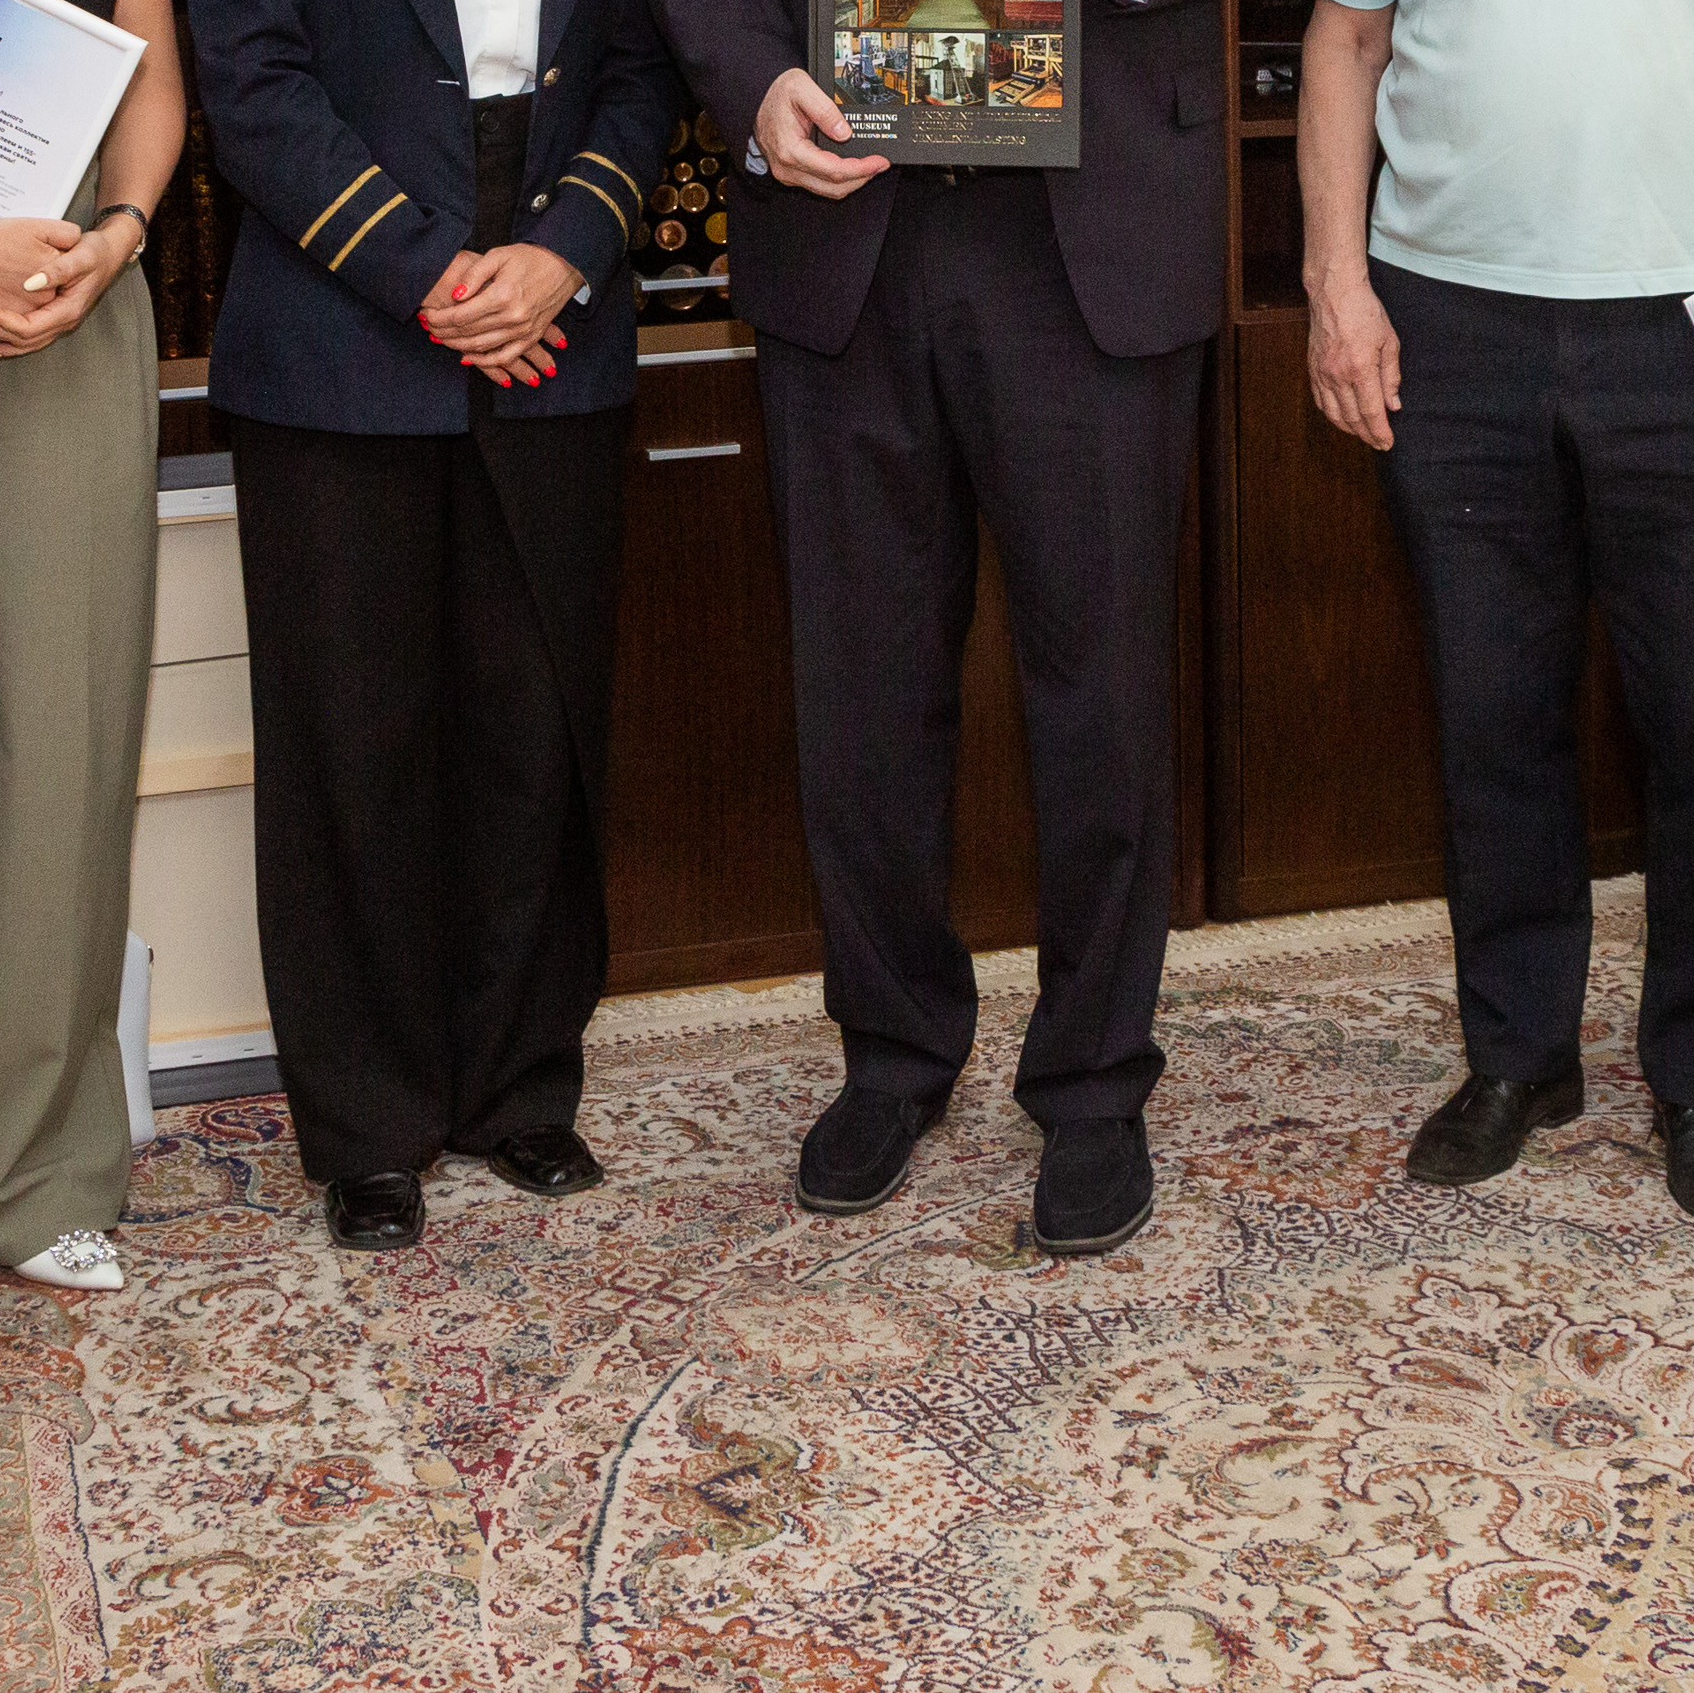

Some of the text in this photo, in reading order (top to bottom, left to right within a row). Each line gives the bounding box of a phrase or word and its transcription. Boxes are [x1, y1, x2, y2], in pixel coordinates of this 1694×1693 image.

[844, 113, 898, 122] THE MINING
[851, 122, 891, 131] MUSEUM
